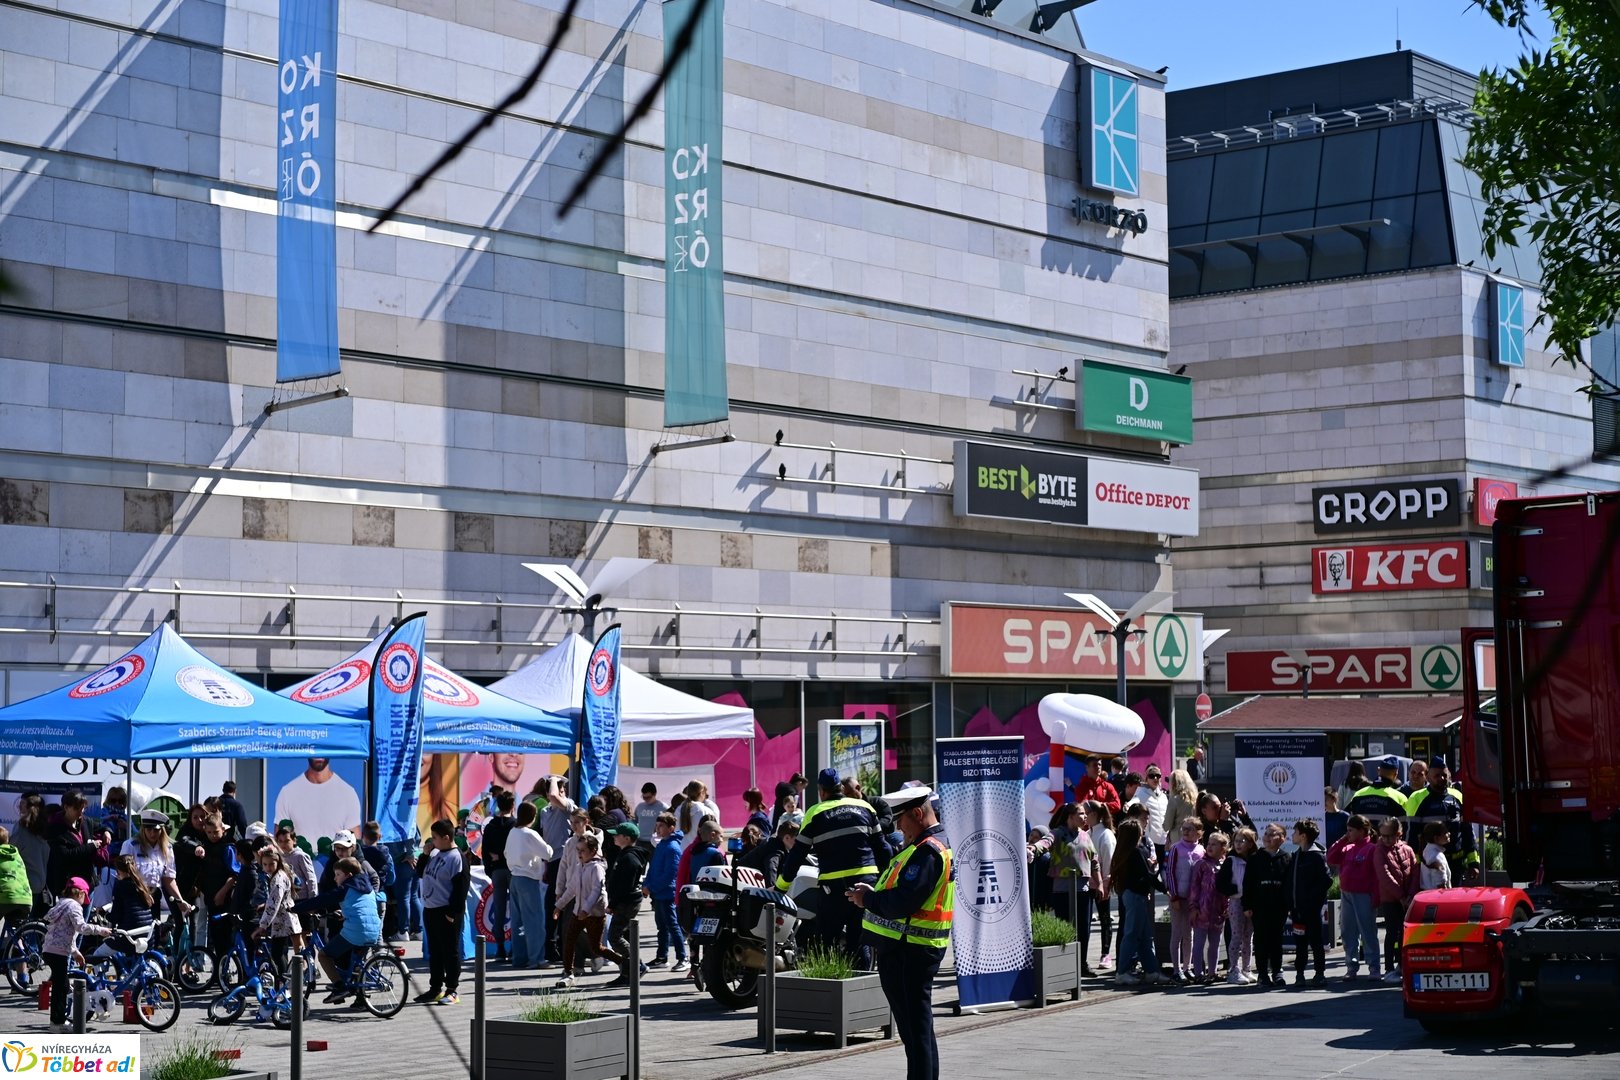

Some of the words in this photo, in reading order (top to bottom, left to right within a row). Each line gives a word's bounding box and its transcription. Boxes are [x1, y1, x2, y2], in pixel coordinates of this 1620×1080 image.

[1129, 377, 1148, 411] D
[1116, 415, 1163, 430] DEICHMANN
[978, 466, 1018, 491] BEST
[1038, 473, 1077, 498] BYTE
[1038, 498, 1077, 508] www.bestbyte.hu
[1095, 482, 1143, 505] Office
[1145, 492, 1190, 510] DEPOT
[1319, 487, 1448, 524] CROPP
[1362, 547, 1458, 586] KFC
[1003, 618, 1141, 666] SPAR
[1271, 654, 1406, 685] SPAR
[3, 725, 75, 736] www.kreszvaltozas.hu
[179, 727, 282, 738] Szabolcs-Szatmár-Bereg
[284, 727, 328, 739] Vármegyei
[436, 720, 521, 732] www.kreszvaltozas.hu
[943, 756, 1019, 766] BALESETMEGELŐZÉSI
[962, 767, 1001, 777] BIZOTTSÁG
[1423, 974, 1485, 988] TRT-111
